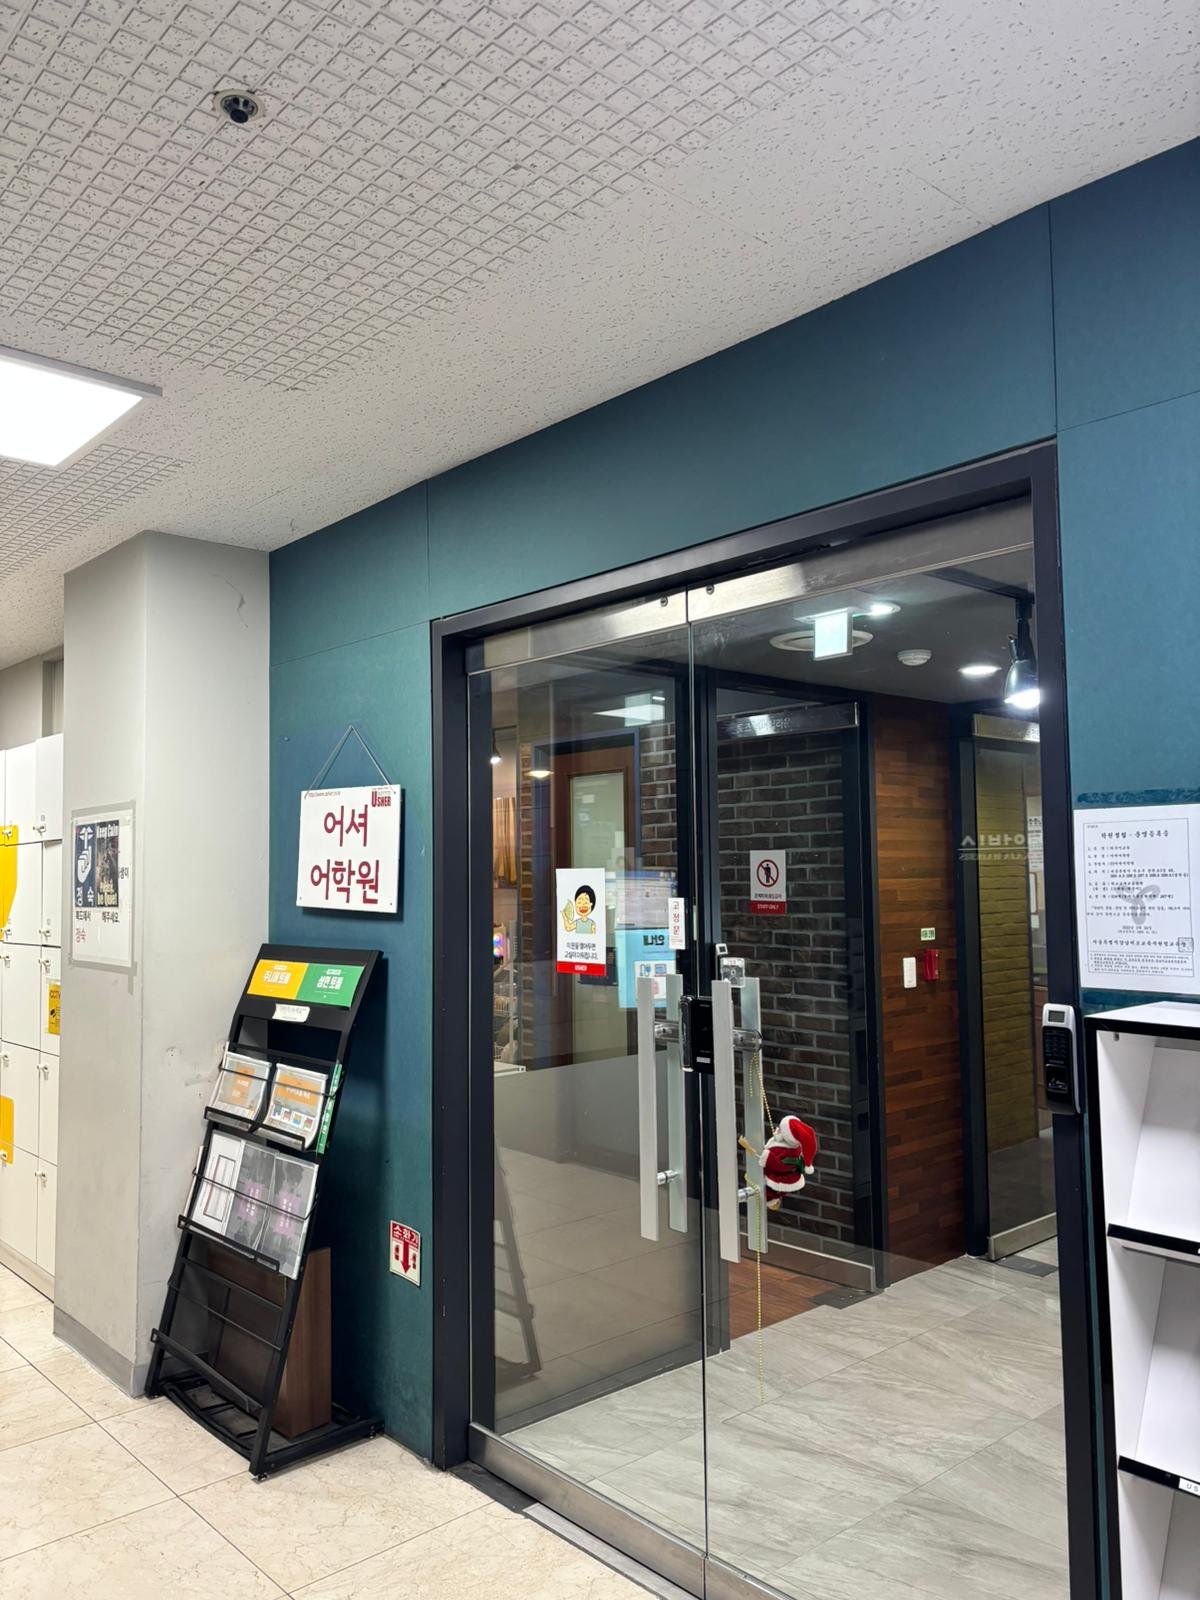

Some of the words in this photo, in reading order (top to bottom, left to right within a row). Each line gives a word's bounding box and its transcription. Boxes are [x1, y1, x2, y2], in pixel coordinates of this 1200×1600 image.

[372, 791, 391, 807] USHER
[324, 804, 368, 847] 어셔
[310, 859, 380, 904] 어학원
[672, 900, 680, 936] 고정문
[393, 1225, 419, 1244] 소화기
